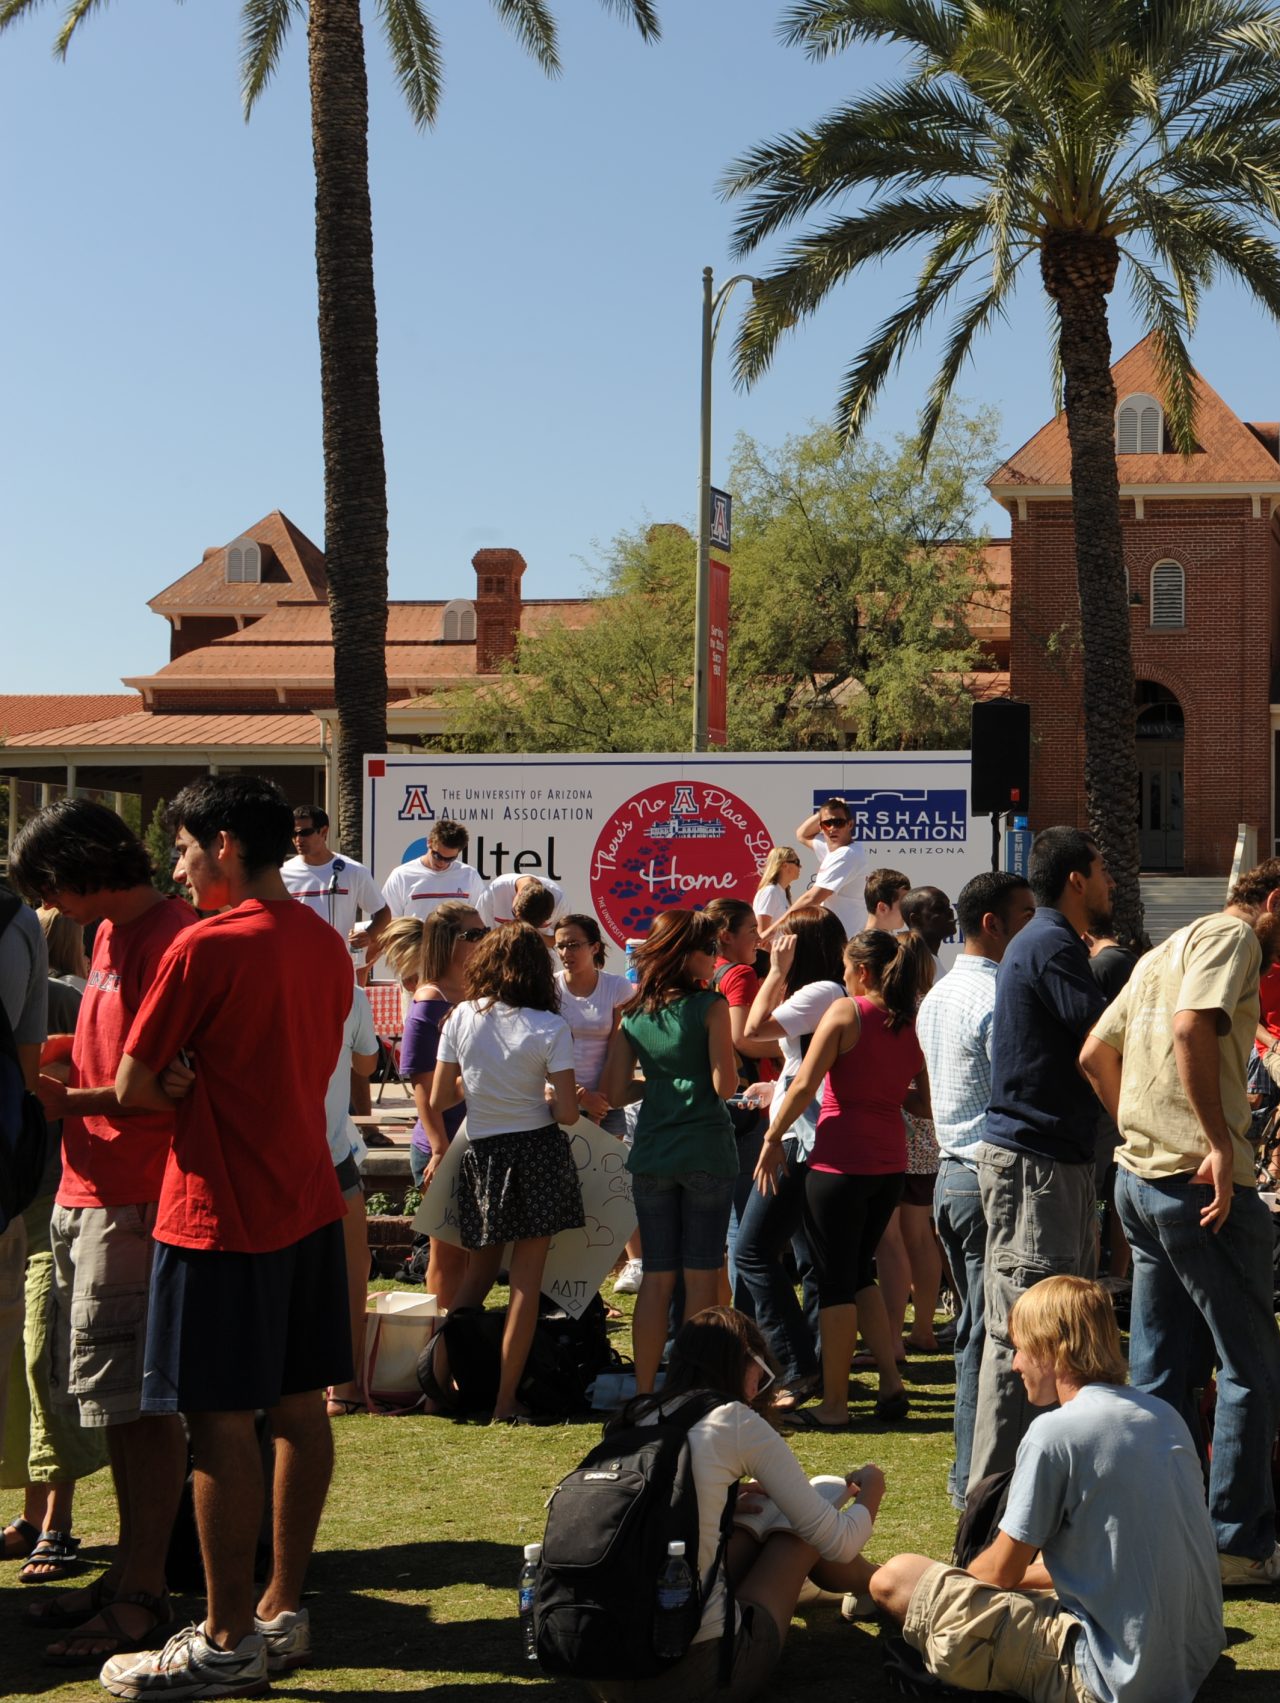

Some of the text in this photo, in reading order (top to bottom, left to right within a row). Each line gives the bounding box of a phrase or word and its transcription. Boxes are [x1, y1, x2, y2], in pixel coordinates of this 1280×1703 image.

[442, 788, 593, 800] THE UNIVERSITY OF ARIZONA
[442, 806, 594, 820] ALUMNI ASSOCIATION
[855, 810, 964, 824] RSHALL
[591, 820, 633, 881] There's
[628, 798, 666, 818] No
[702, 789, 748, 830] Place
[851, 826, 964, 840] UNDATION
[639, 856, 738, 892] Home
[597, 896, 626, 940] THE UNIVERSITY
